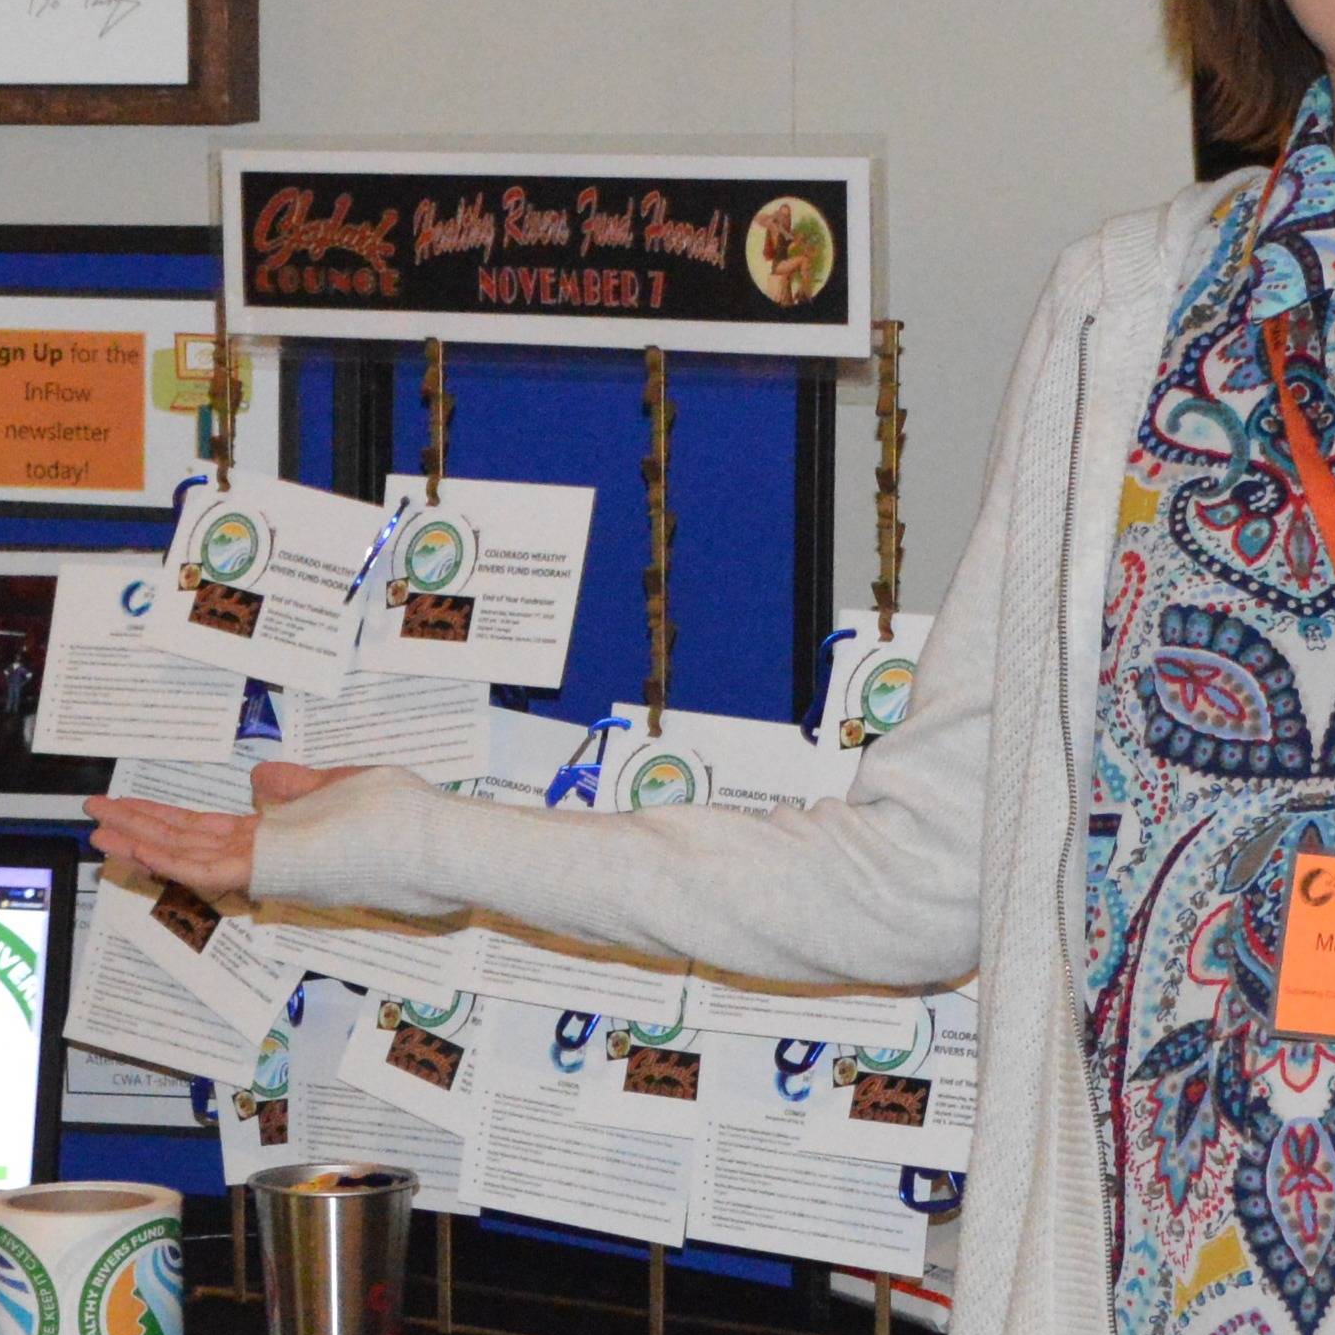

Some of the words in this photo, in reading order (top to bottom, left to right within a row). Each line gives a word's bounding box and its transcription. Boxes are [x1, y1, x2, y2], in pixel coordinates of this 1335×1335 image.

[412, 191, 495, 265] Healthy
[501, 186, 569, 250] Rivers
[577, 186, 635, 257] Fund
[477, 266, 640, 308] NOVEMBER
[647, 269, 667, 308] 7
[33, 343, 64, 367] Up
[70, 345, 100, 364] for
[106, 345, 140, 364] the
[24, 381, 92, 402] InFlow
[4, 421, 111, 442] newsletter
[25, 461, 90, 484] today!
[278, 549, 321, 569] COLORADO
[322, 562, 357, 577] HEALTHY
[484, 548, 529, 561] COLORADO
[531, 552, 567, 563] HEALTHY
[270, 565, 297, 579] RIVERS
[297, 570, 320, 585] FUND
[320, 577, 352, 592] HOORA
[477, 564, 506, 575] RIVERS
[507, 566, 530, 577] FUND
[531, 567, 571, 579] HOORAH!
[485, 776, 533, 795] COLORADO
[718, 786, 768, 801] COLORADO
[941, 1029, 978, 1043] COLORA
[934, 1045, 965, 1058] RIVERS
[92, 1244, 131, 1287] RIVERS
[131, 1224, 165, 1250] FUND
[41, 1287, 56, 1321] KEEP
